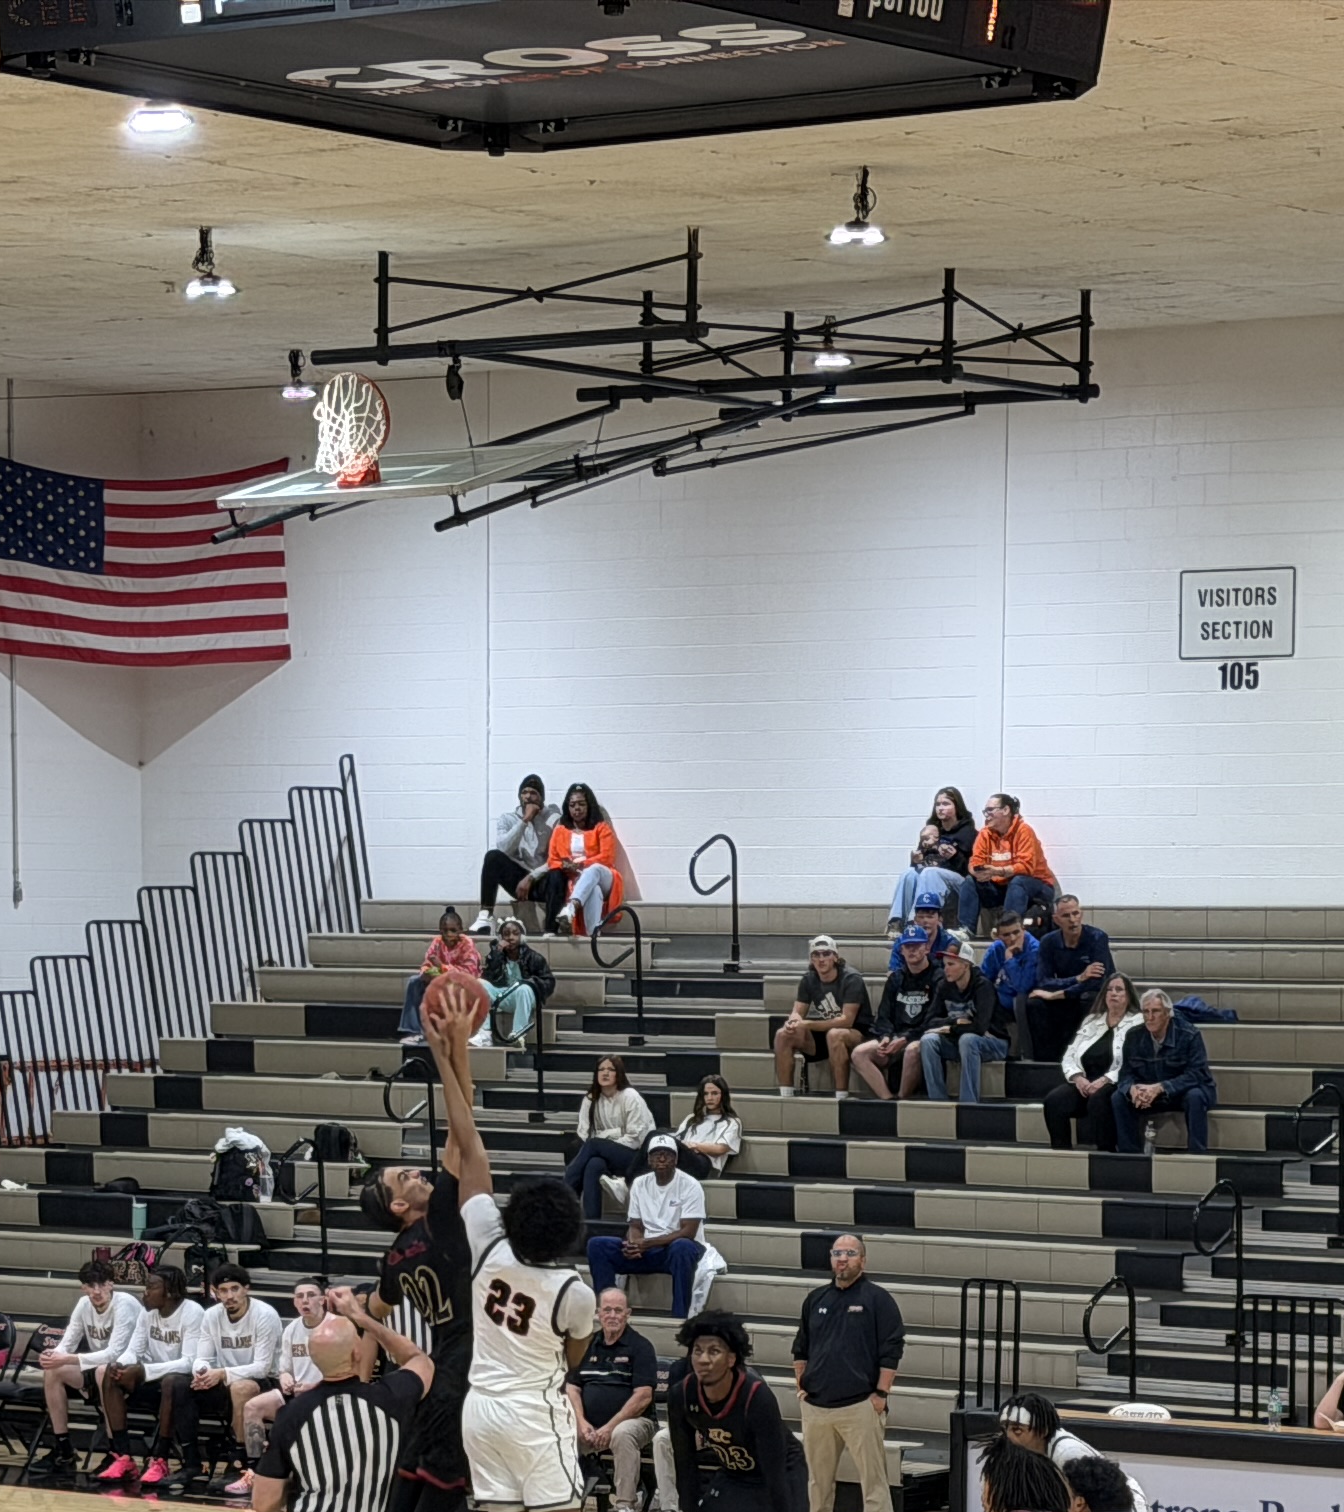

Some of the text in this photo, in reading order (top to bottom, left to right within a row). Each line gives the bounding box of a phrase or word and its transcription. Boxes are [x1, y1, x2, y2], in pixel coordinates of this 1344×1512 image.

[286, 23, 806, 89] CROSS
[1198, 586, 1276, 607] VISITORS
[1200, 620, 1272, 640] SECTION
[1218, 662, 1259, 690] 105
[484, 1278, 536, 1336] 23
